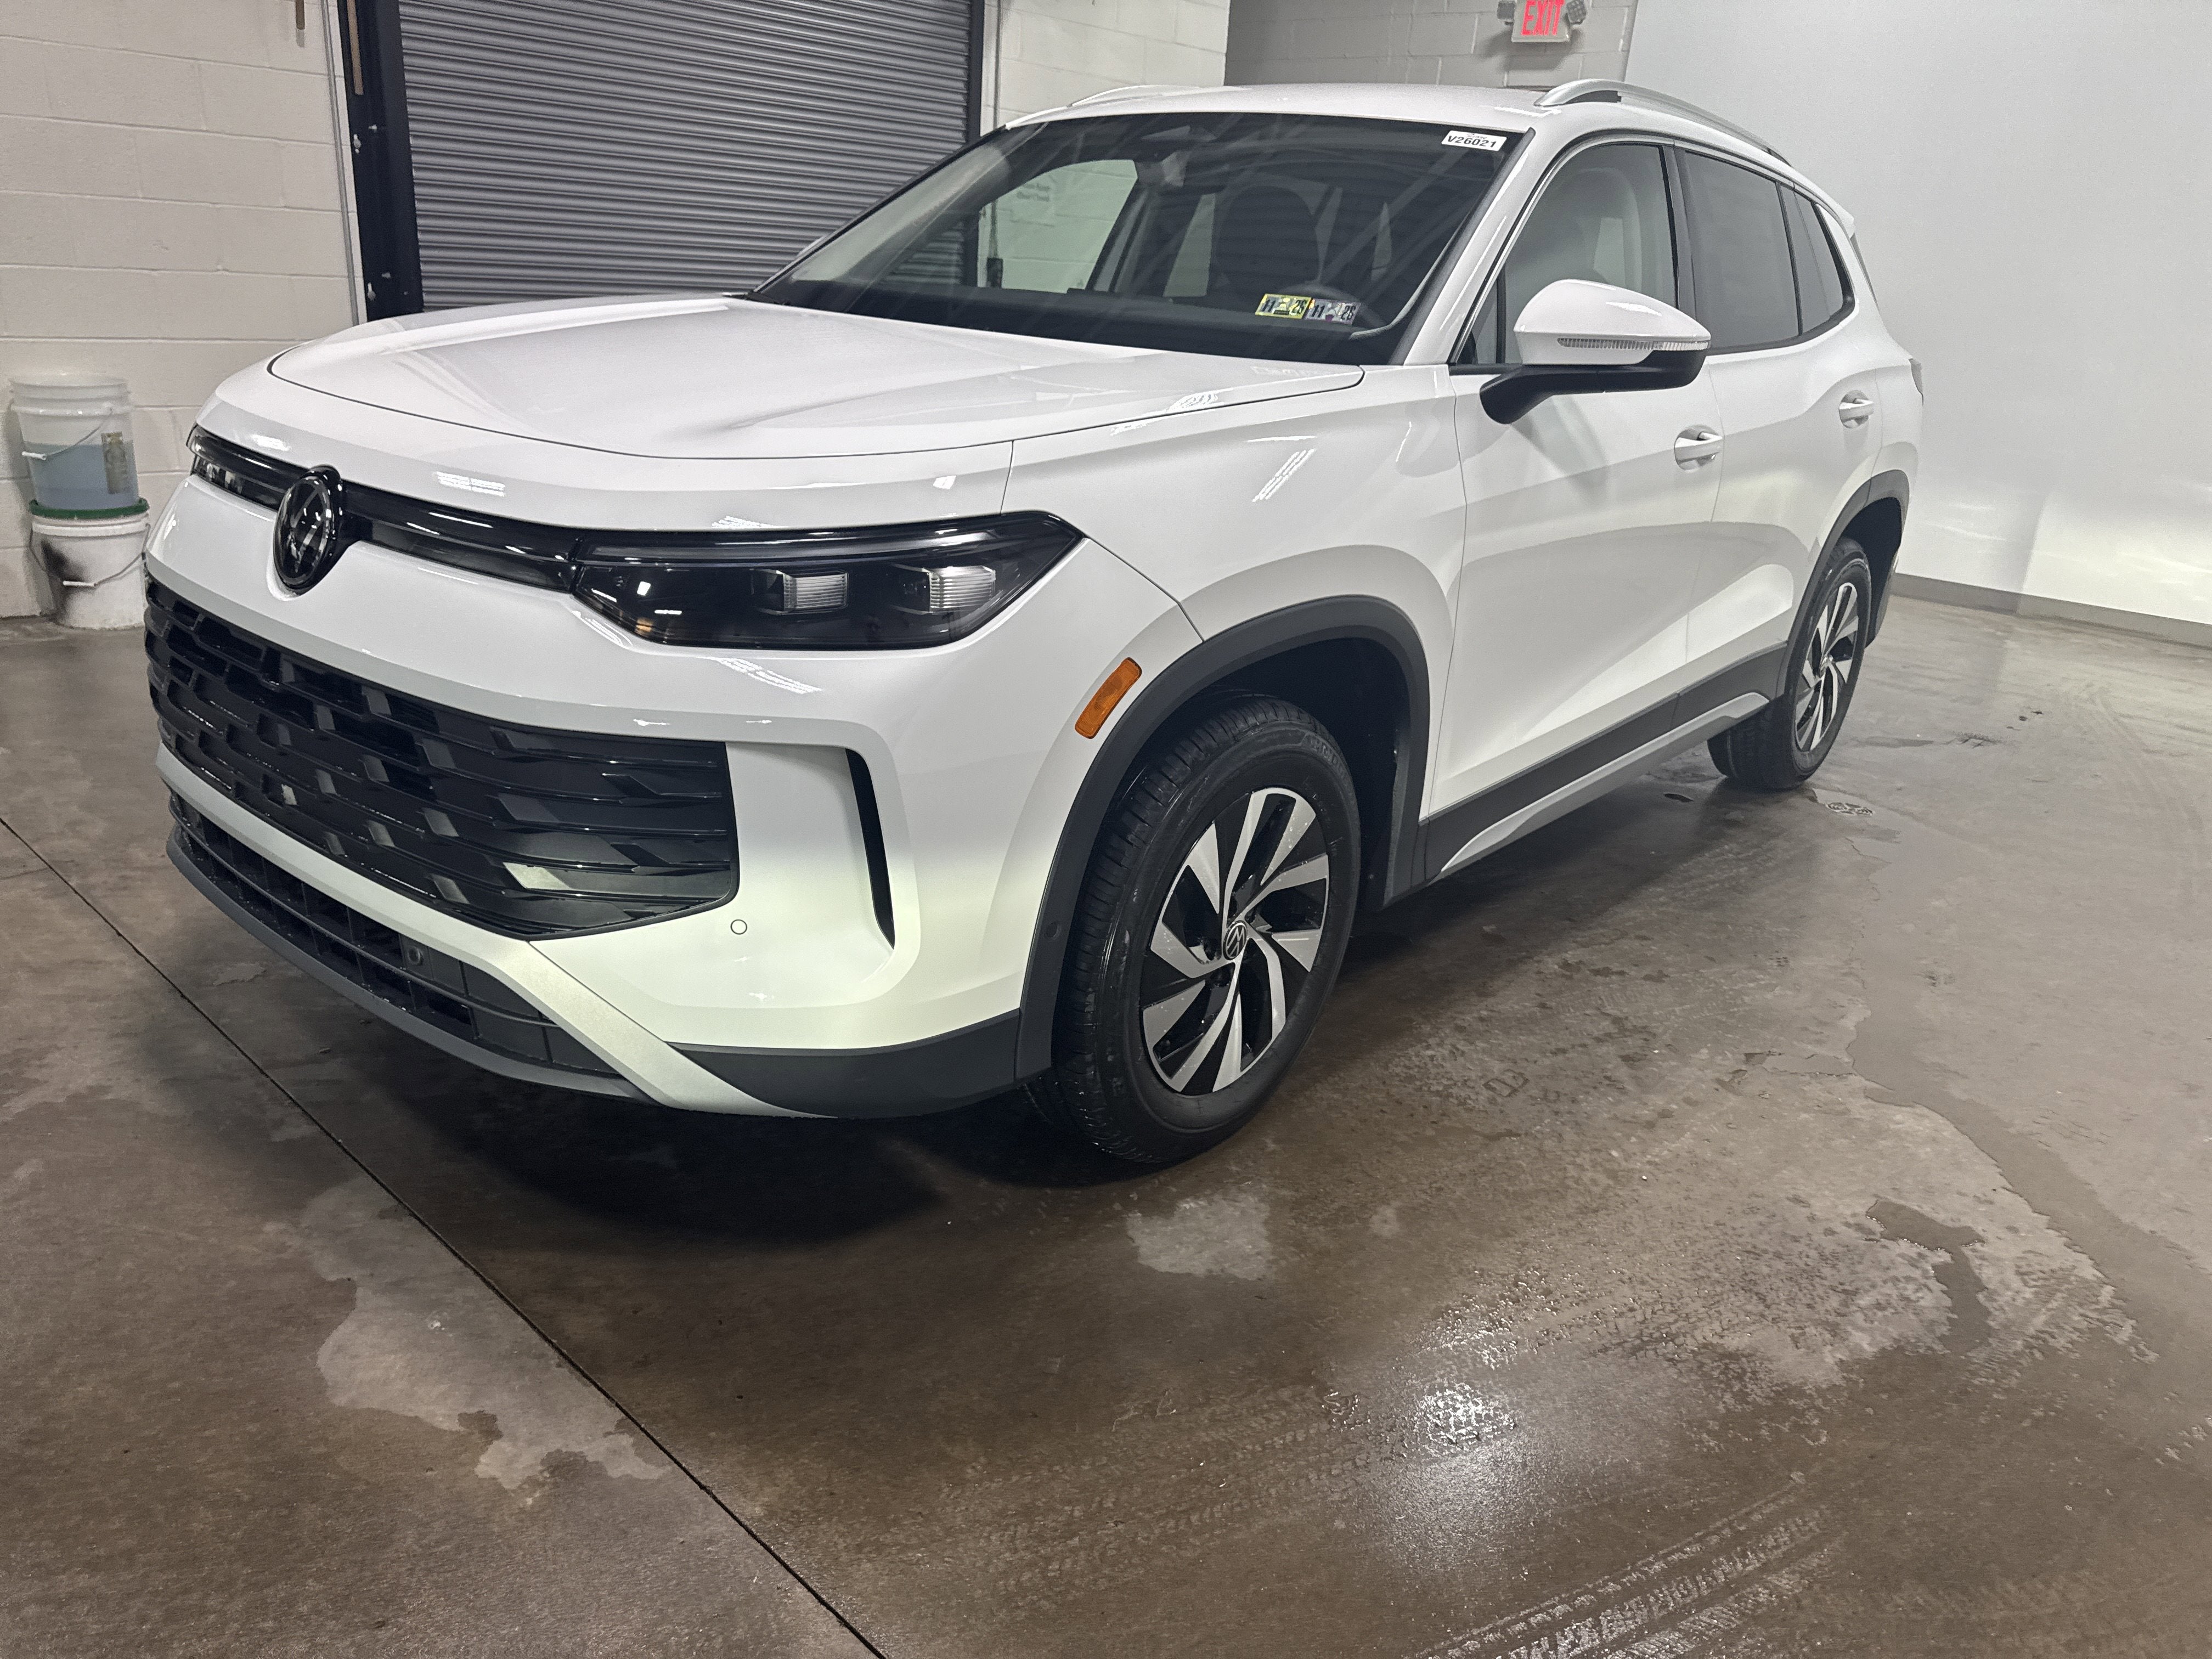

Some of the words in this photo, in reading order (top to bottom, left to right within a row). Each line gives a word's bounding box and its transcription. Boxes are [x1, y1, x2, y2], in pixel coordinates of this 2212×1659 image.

[1520, 0, 1565, 36] EXIT
[1447, 135, 1497, 148] V26021
[1262, 299, 1276, 313] 11
[1311, 304, 1325, 318] 11
